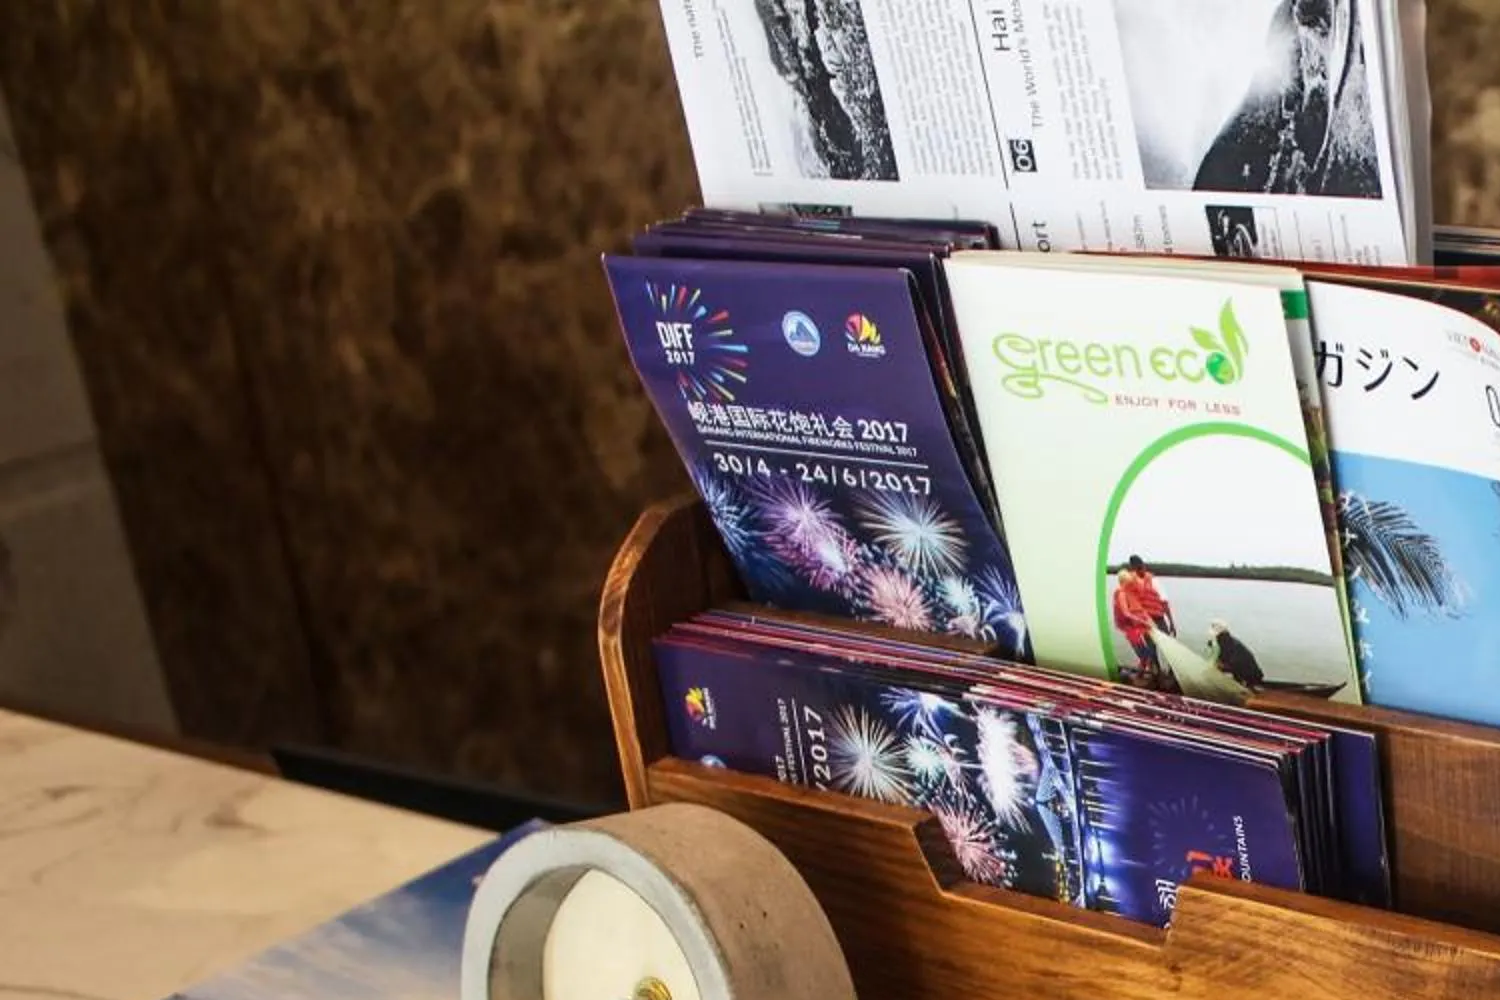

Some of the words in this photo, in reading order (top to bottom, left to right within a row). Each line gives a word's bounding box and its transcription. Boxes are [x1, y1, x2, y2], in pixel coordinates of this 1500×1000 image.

[992, 9, 1010, 51] Hai
[1018, 37, 1037, 97] World's
[1030, 101, 1043, 128] The
[1013, 140, 1033, 171] 06
[1032, 220, 1050, 252] ort
[655, 321, 693, 348] DIFF
[665, 349, 695, 365] 2017
[1316, 340, 1439, 399] ガジン
[1115, 394, 1159, 408] ENJOY
[1168, 398, 1197, 411] FOR
[1205, 402, 1241, 416] LESS
[857, 418, 908, 443] 2017
[1233, 815, 1251, 883] OUNTAINS
